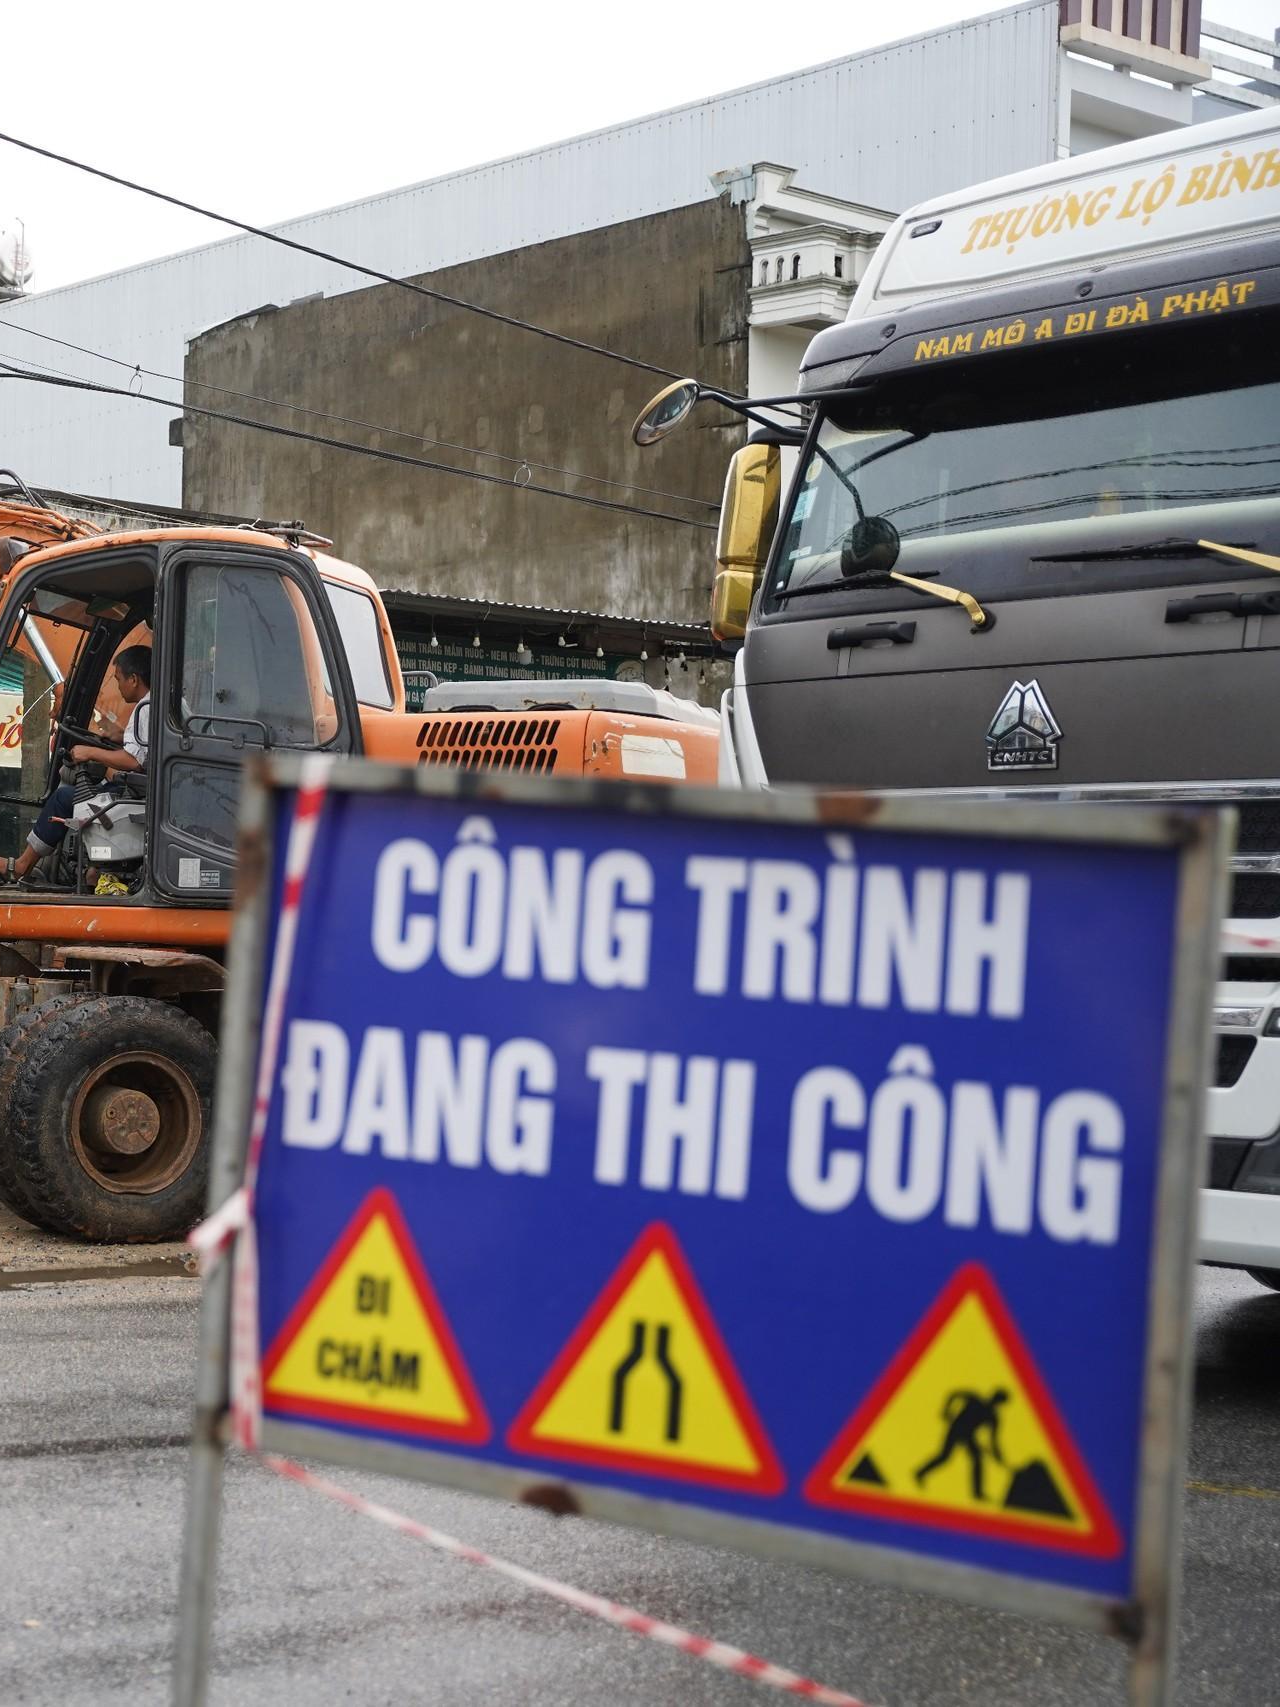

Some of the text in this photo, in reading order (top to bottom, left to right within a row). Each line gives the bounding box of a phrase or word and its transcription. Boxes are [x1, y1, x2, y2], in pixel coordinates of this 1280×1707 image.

[1116, 163, 1176, 226] LỘ
[914, 332, 974, 362] NAM
[980, 319, 1025, 351] MÔ
[1034, 318, 1053, 341] A
[1105, 296, 1150, 329] ĐÀ
[1161, 280, 1257, 319] PHẬT
[994, 750, 1049, 762] CNHTC
[371, 816, 1030, 1019] CÔNG TRÌNH
[281, 1018, 1124, 1245] ĐANG THI CÔNG
[356, 1273, 391, 1318] ĐI
[317, 1335, 421, 1397] CHẬM
